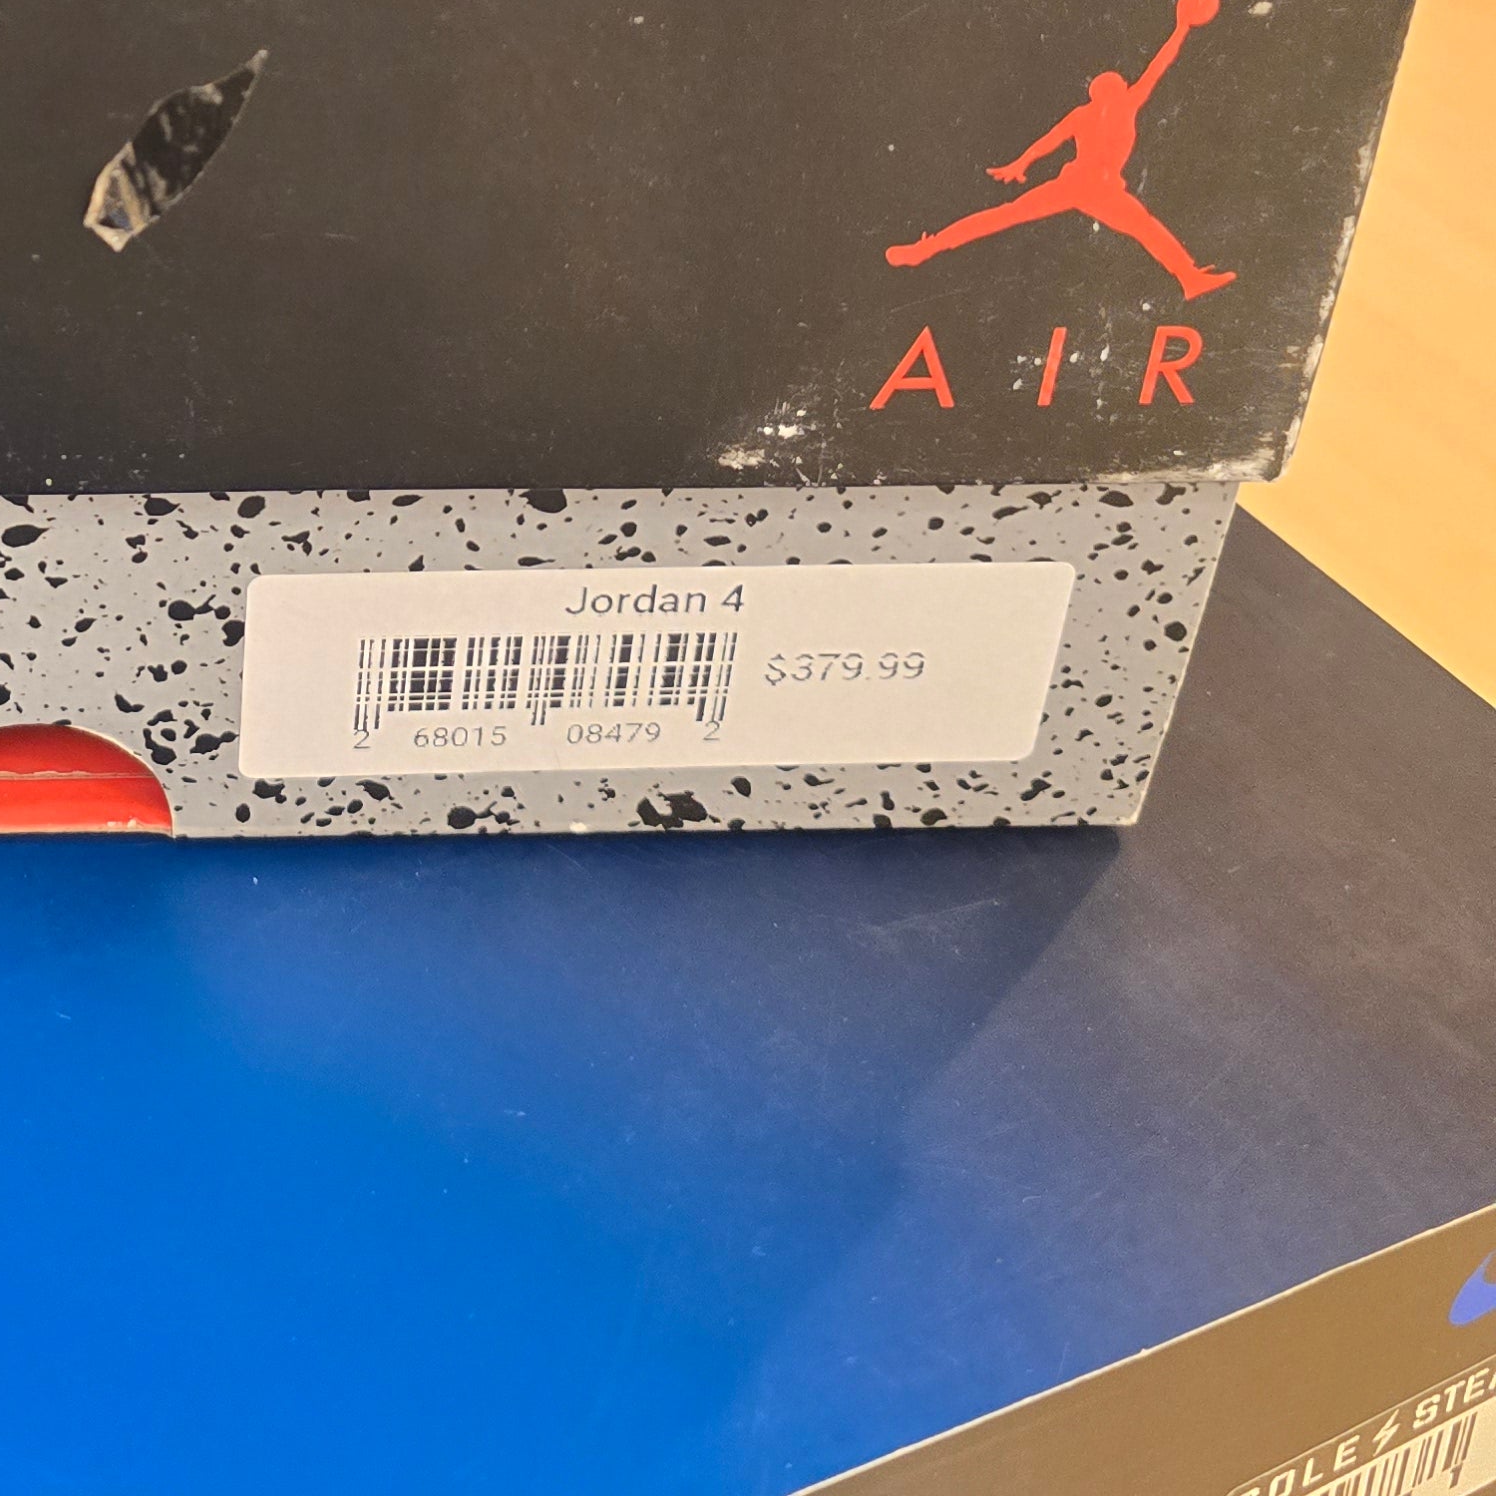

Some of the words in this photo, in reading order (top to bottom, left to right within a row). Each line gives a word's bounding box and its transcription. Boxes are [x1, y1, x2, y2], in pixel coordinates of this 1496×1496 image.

[868, 325, 1204, 411] AIR
[564, 584, 707, 616] Jordan
[720, 584, 745, 612] 4
[765, 651, 926, 686] $379.99
[353, 728, 371, 750] 2
[413, 725, 507, 748] 68015
[565, 721, 662, 745] 08479
[702, 720, 721, 743] 2
[1240, 1434, 1361, 1496] OLE
